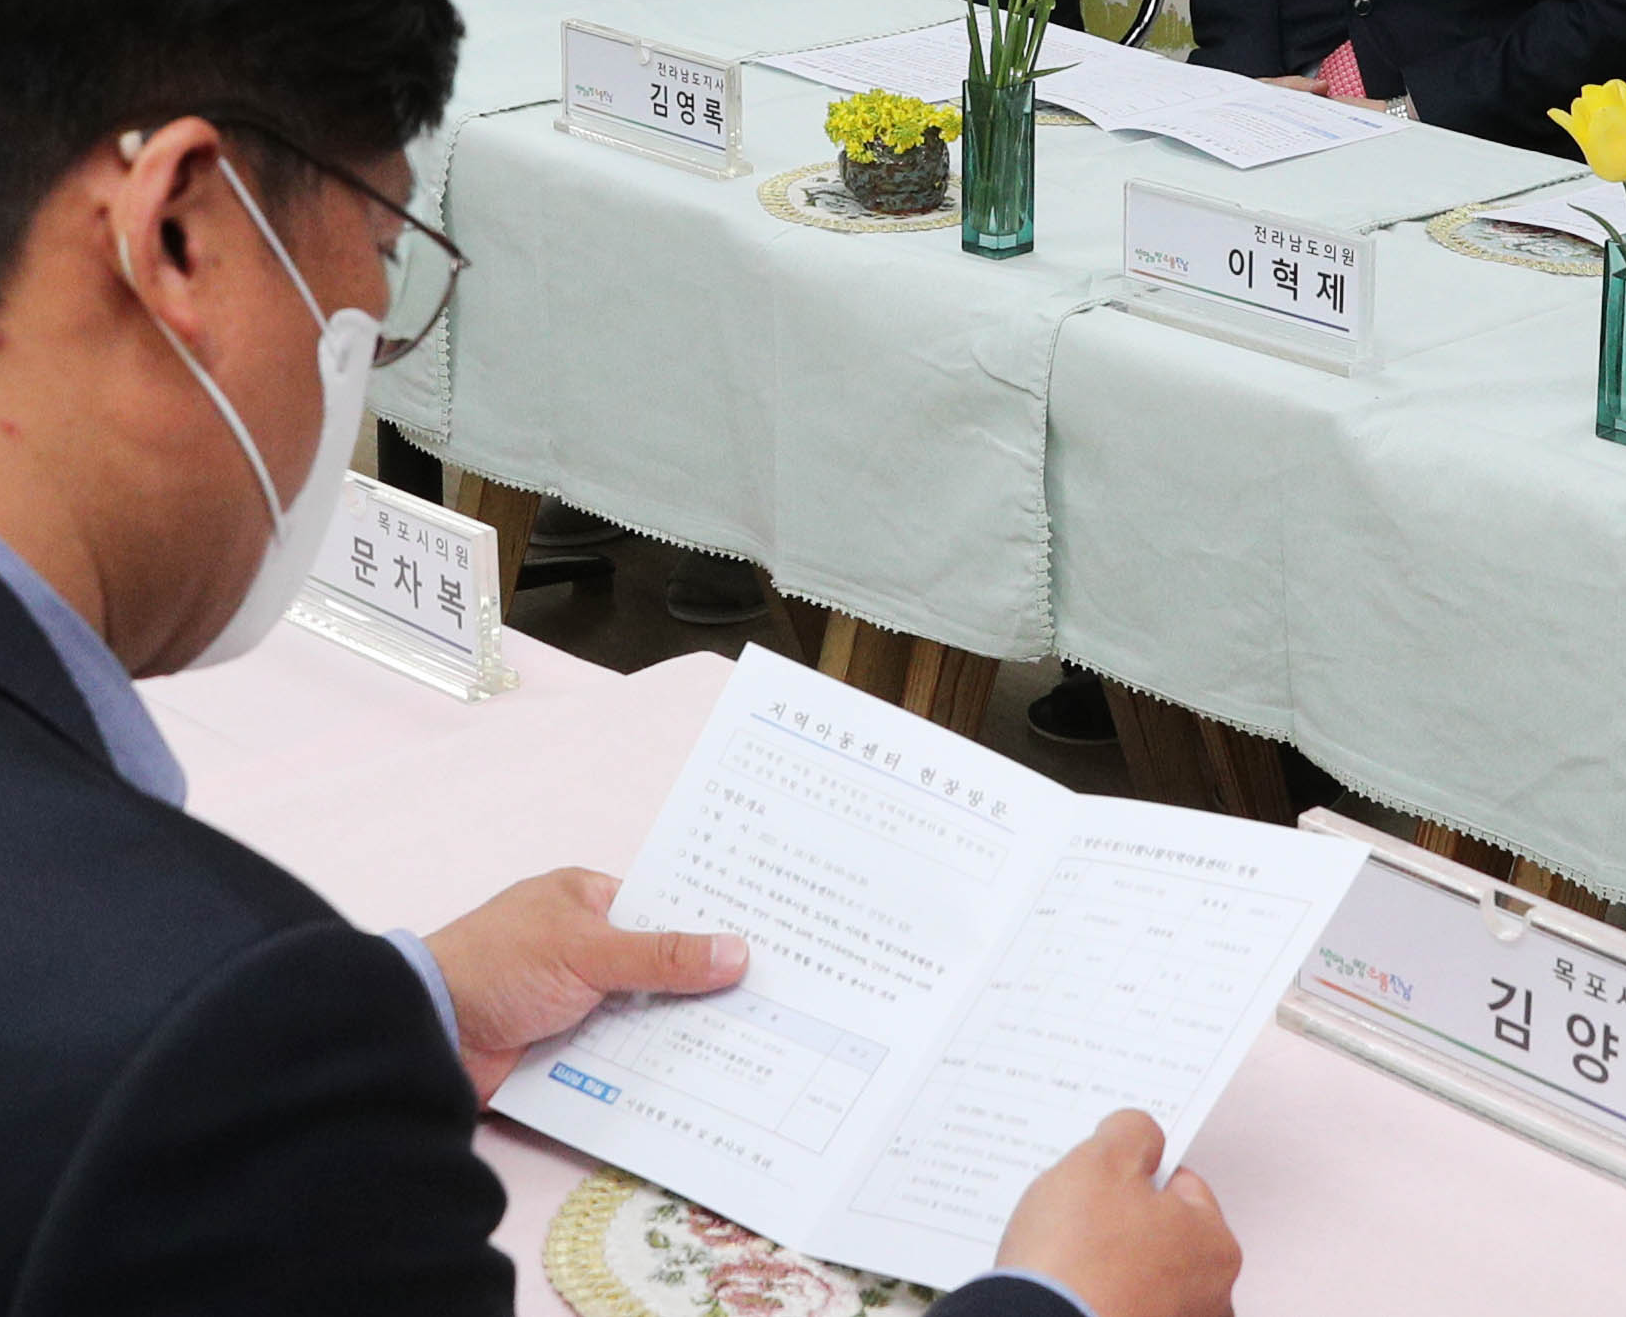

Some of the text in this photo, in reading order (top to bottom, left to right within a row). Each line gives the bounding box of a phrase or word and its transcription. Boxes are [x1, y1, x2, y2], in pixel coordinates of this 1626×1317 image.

[657, 62, 724, 93] 전라남도지사
[650, 83, 724, 134] 김영록
[1254, 225, 1355, 267] 전라남도의원
[1229, 248, 1344, 314] 이혁제
[377, 511, 469, 570] 목포시의원
[351, 536, 467, 629] 문차복
[767, 700, 903, 771] 지역아동센터
[919, 766, 1009, 819] 현장방문
